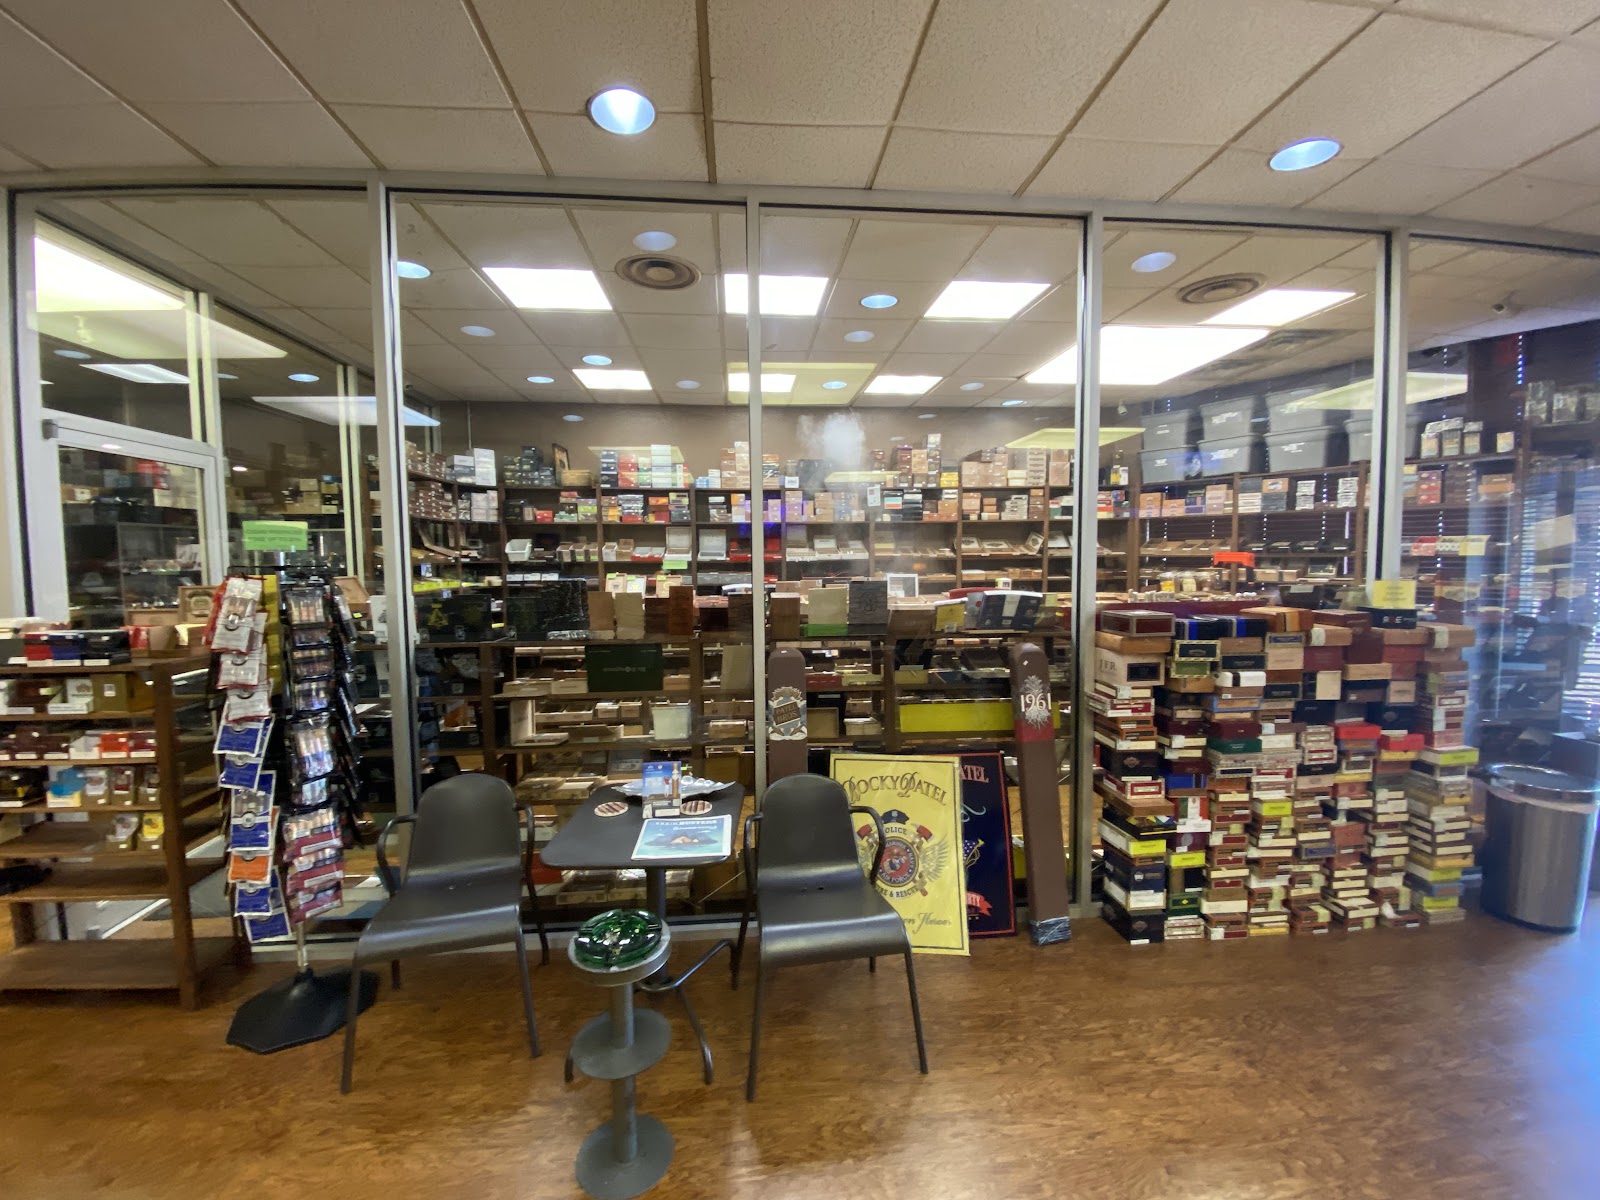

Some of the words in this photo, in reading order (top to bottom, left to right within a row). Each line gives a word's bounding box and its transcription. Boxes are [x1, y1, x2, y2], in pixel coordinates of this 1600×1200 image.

[1020, 692, 1052, 712] 1961
[959, 764, 989, 783] ATEL
[884, 826, 907, 835] OLICE
